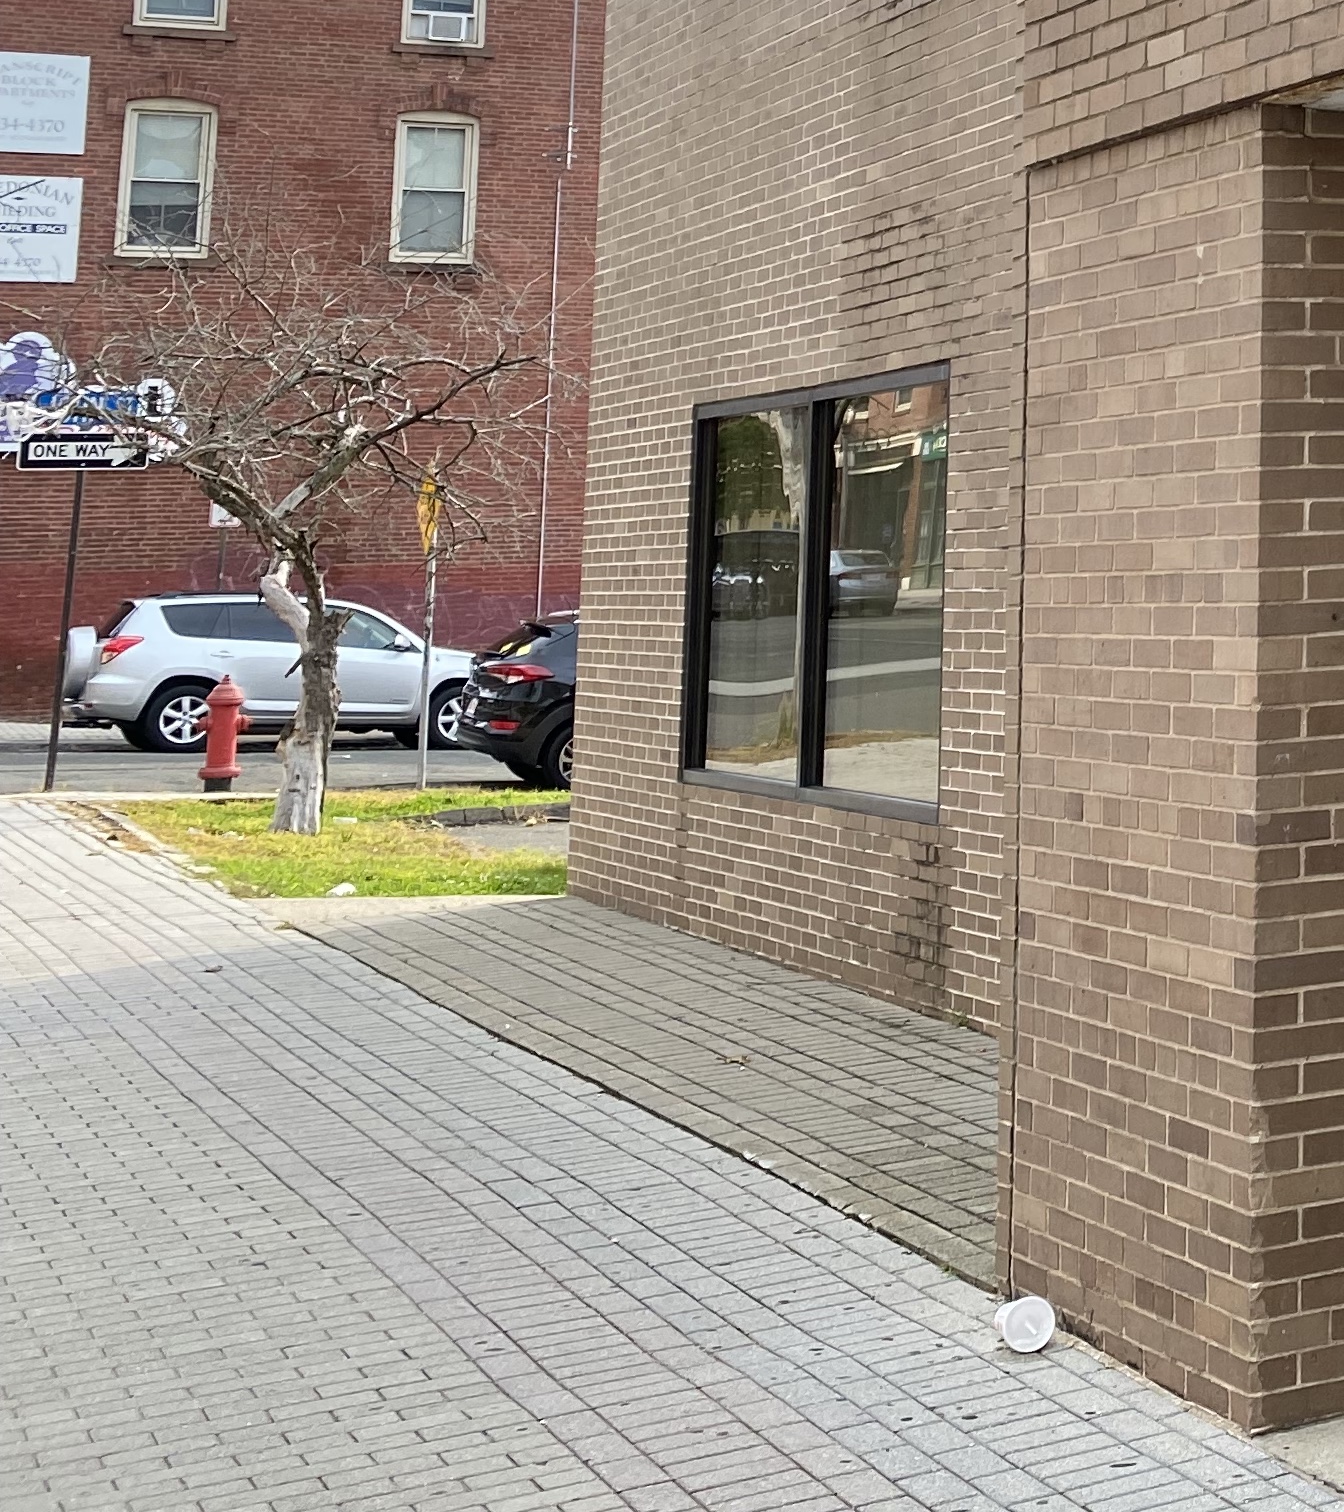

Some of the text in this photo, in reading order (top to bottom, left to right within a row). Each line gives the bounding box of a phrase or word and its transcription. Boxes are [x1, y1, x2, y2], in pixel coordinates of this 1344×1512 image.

[35, 224, 66, 234] SPACE
[33, 443, 111, 458] ONE WAY
